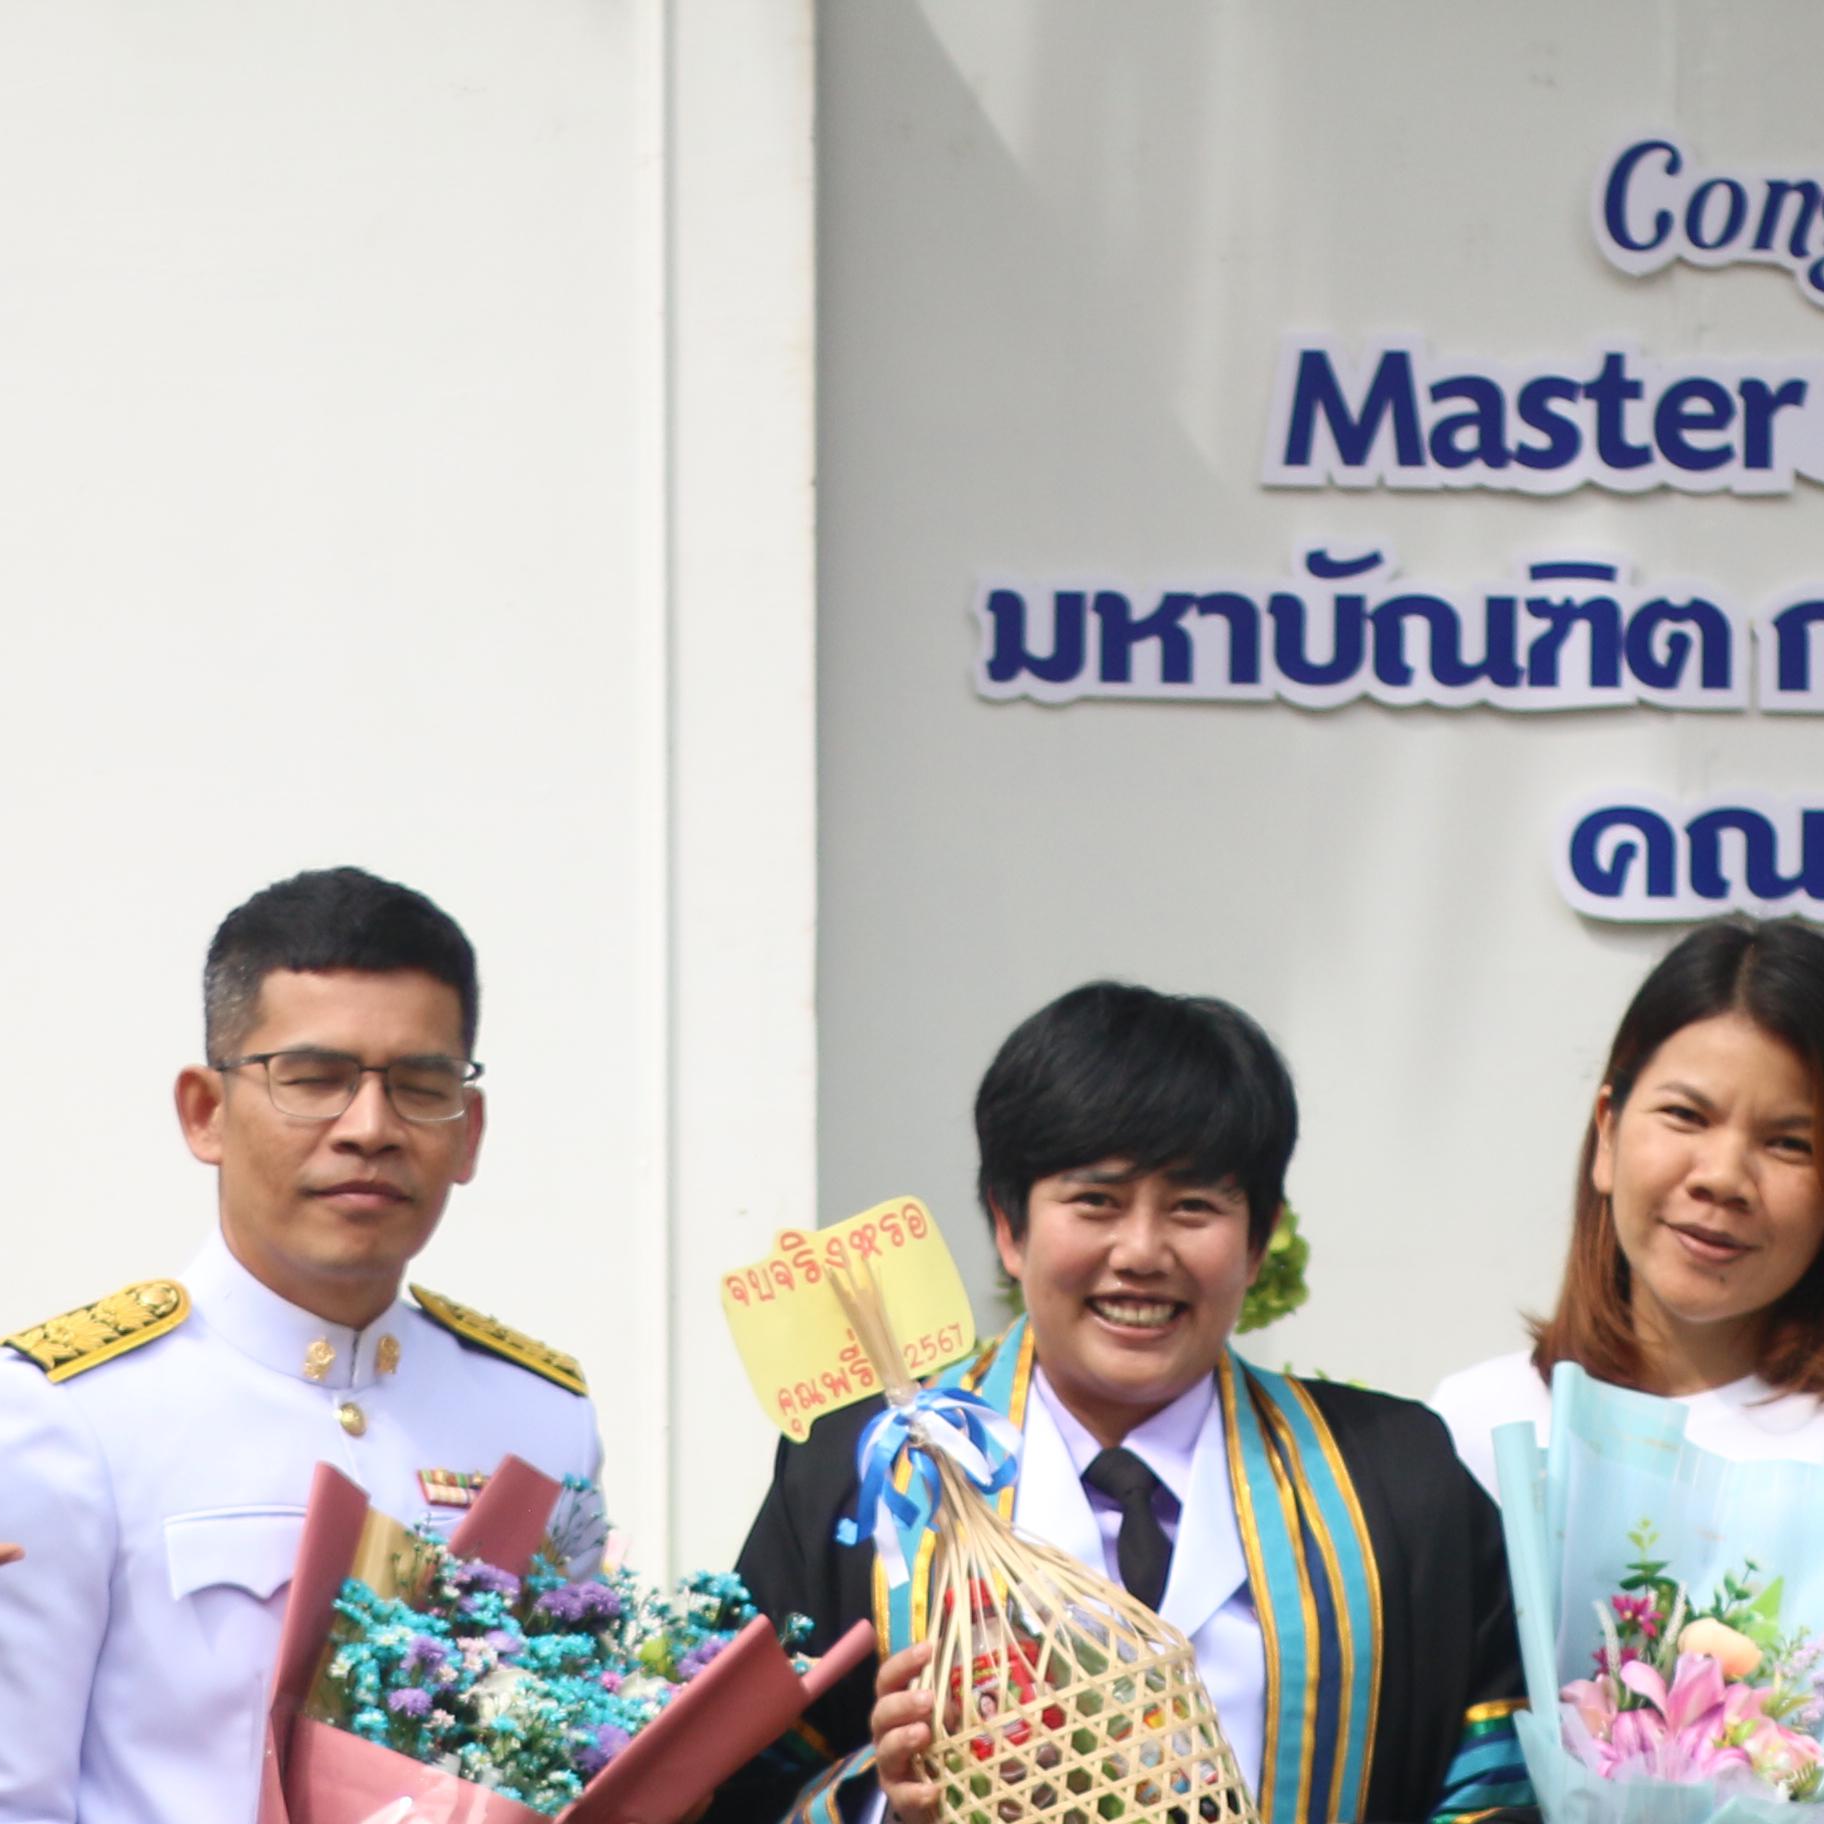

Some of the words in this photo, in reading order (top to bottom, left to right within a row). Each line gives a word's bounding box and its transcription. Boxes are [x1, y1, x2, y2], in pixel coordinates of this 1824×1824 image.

[1285, 350, 1807, 470] Master
[987, 550, 1731, 689] มหาบัณฑิต
[904, 1322, 964, 1369] 2567
